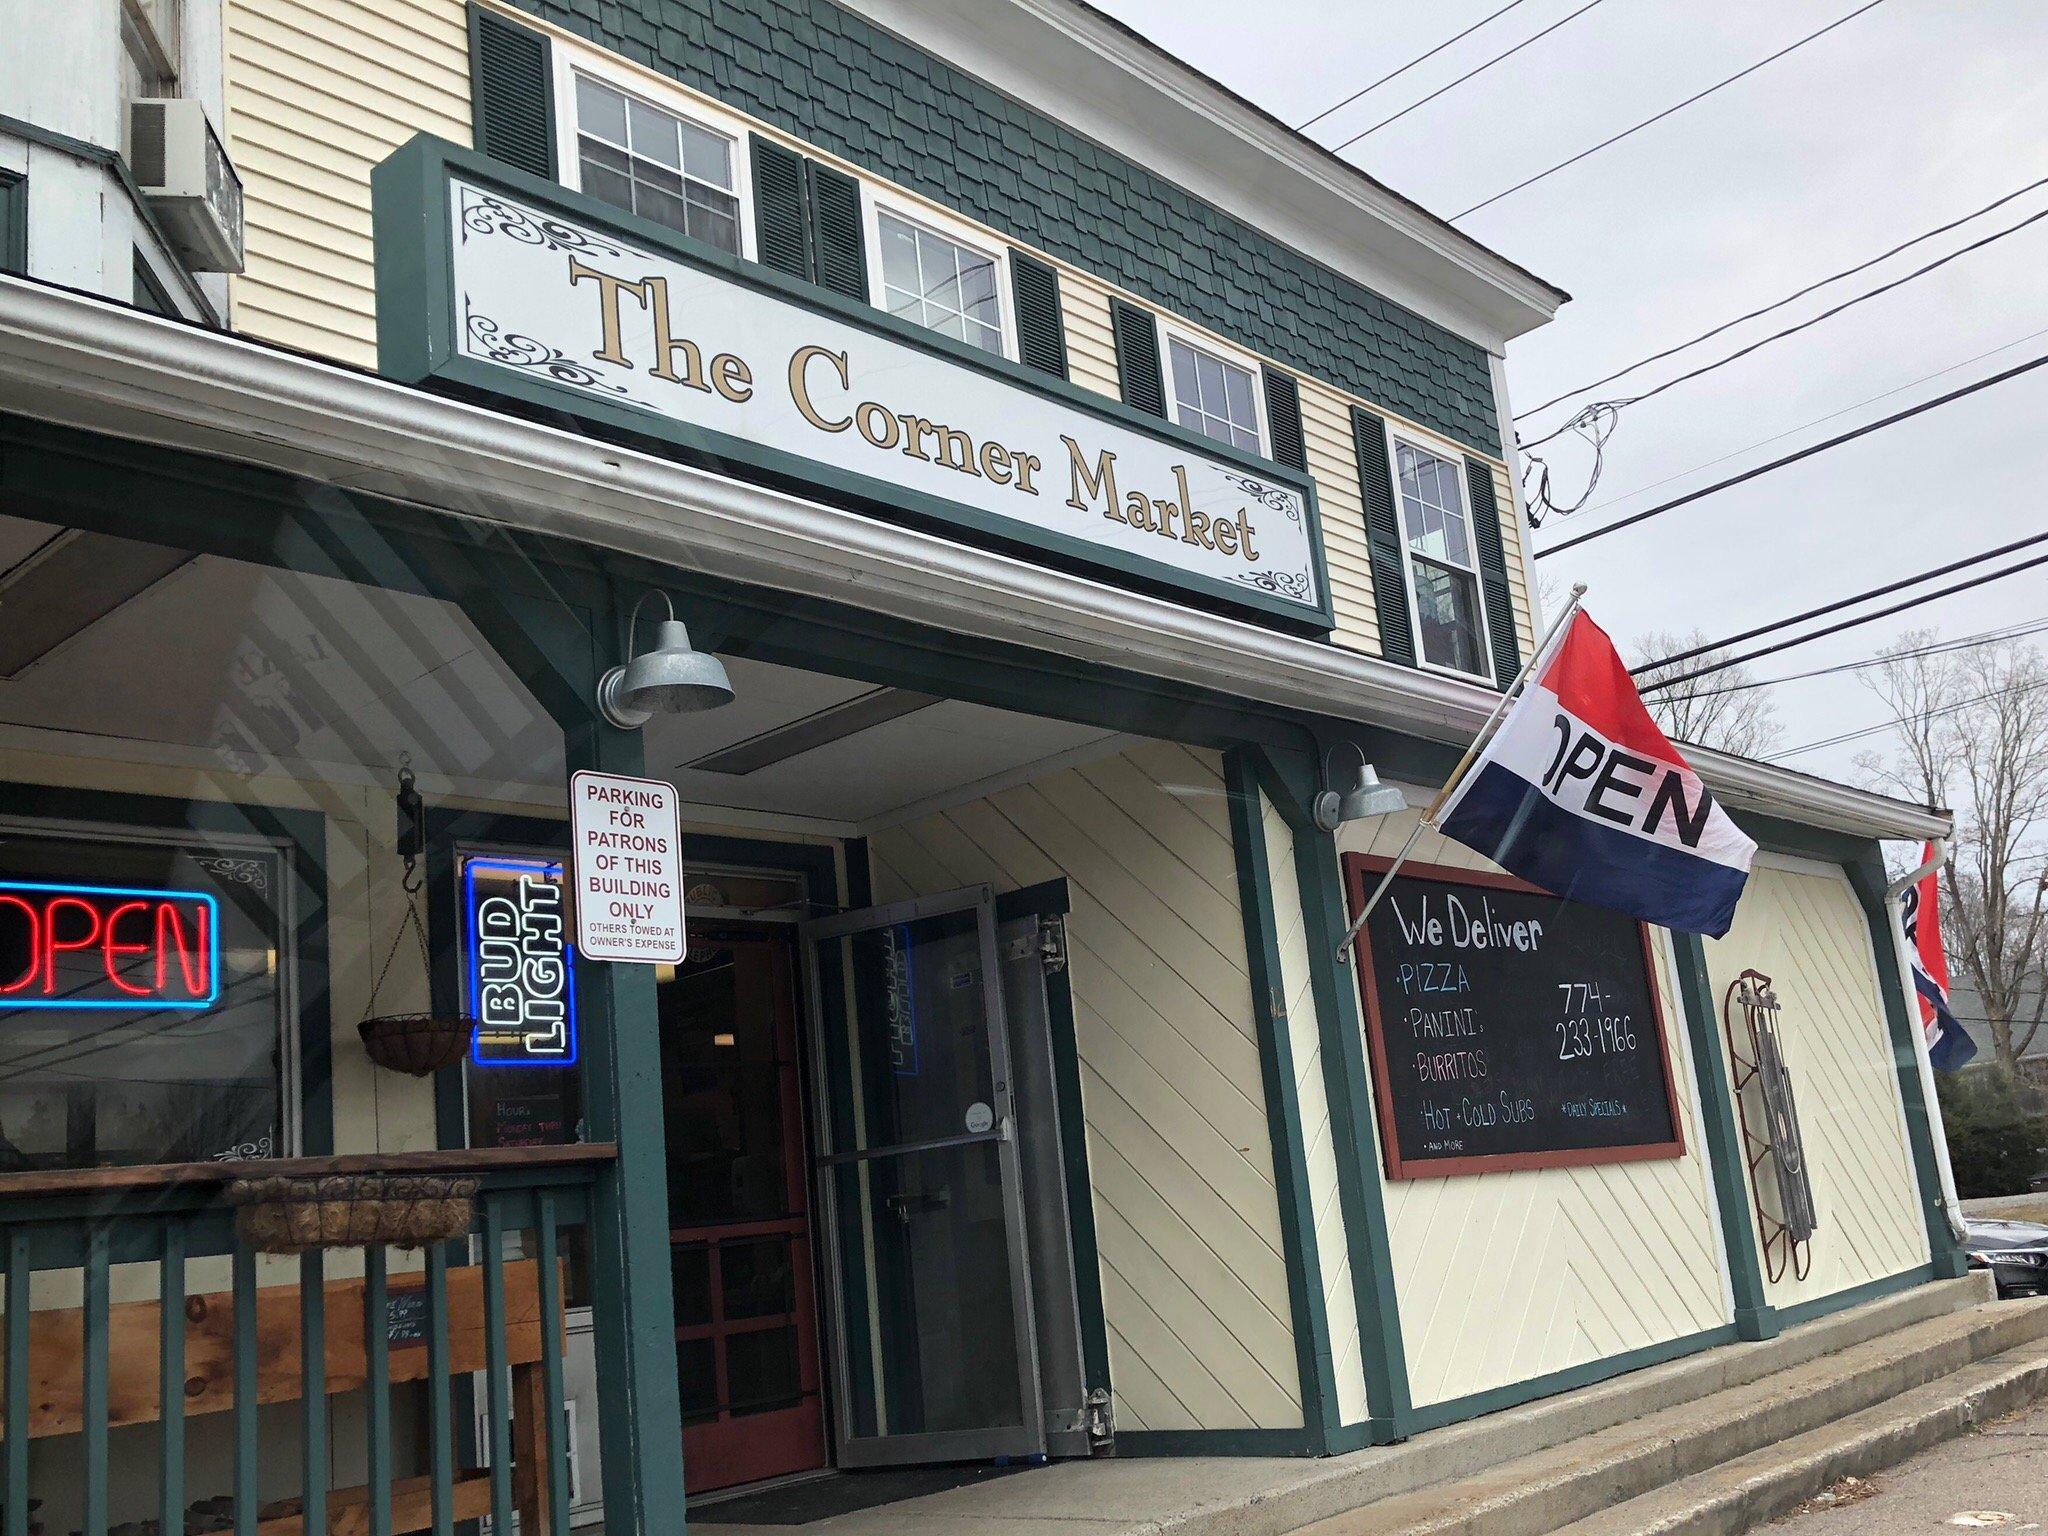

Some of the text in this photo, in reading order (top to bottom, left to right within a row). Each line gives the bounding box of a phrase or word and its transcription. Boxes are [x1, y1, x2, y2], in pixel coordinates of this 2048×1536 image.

[568, 254, 1260, 562] The Corner Market
[587, 784, 664, 810] PARKING
[609, 810, 645, 829] FOR
[587, 830, 667, 854] PATRONS
[595, 854, 662, 875] OF THIS
[589, 876, 671, 899] BUILDING
[609, 901, 654, 920] ONLY
[1390, 893, 1543, 952] We Deliver
[589, 922, 675, 937] OTHERS TOWED AT
[589, 936, 676, 950] OWNER'S EXPENSE
[478, 896, 524, 1026] BUD
[519, 873, 566, 1054] LIGHT
[1400, 963, 1471, 995] PIZZA
[1556, 1015, 1637, 1060] 233-1966
[1416, 1049, 1487, 1082] BURRITOS
